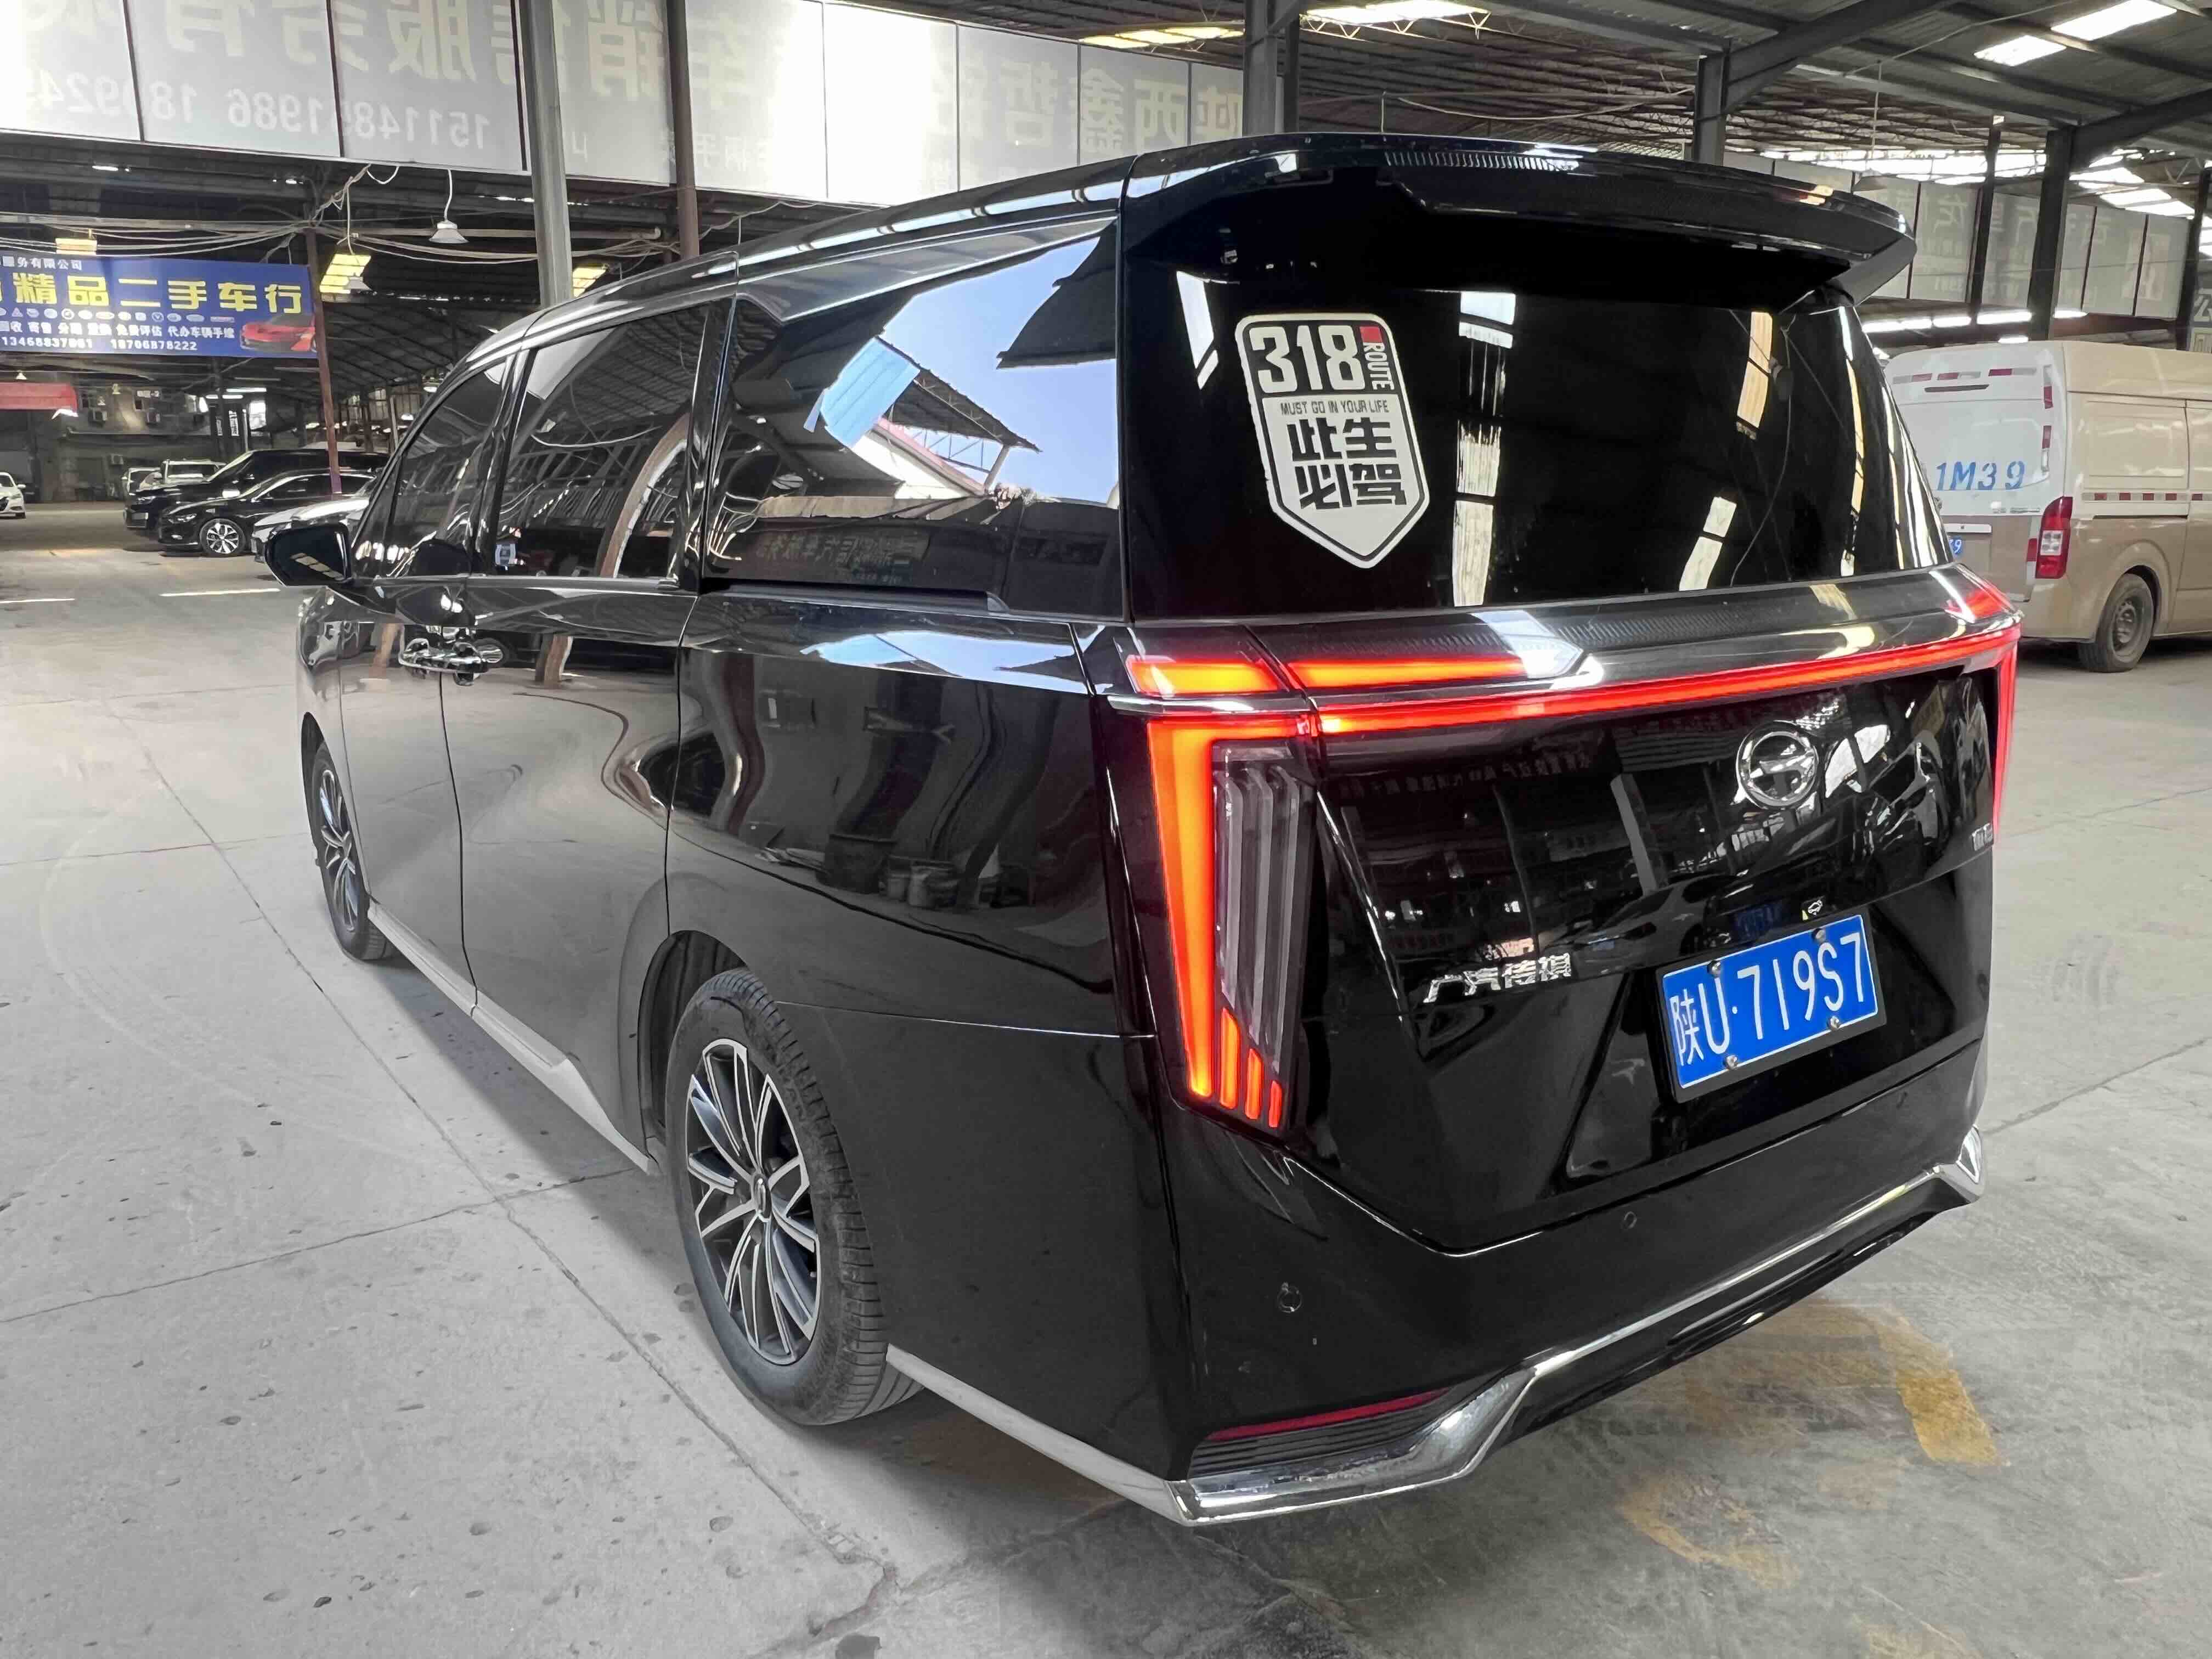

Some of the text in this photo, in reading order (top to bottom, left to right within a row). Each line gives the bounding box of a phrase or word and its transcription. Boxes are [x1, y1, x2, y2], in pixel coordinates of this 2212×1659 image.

[0, 272, 301, 313] 精品二手车行
[1249, 325, 1365, 393] 318
[1363, 342, 1395, 391] ROUTE
[1280, 399, 1390, 416] MUST GO IN YOUR LIFE
[1286, 417, 1397, 462] 此生
[1669, 932, 1864, 1066] 陕U·719S7
